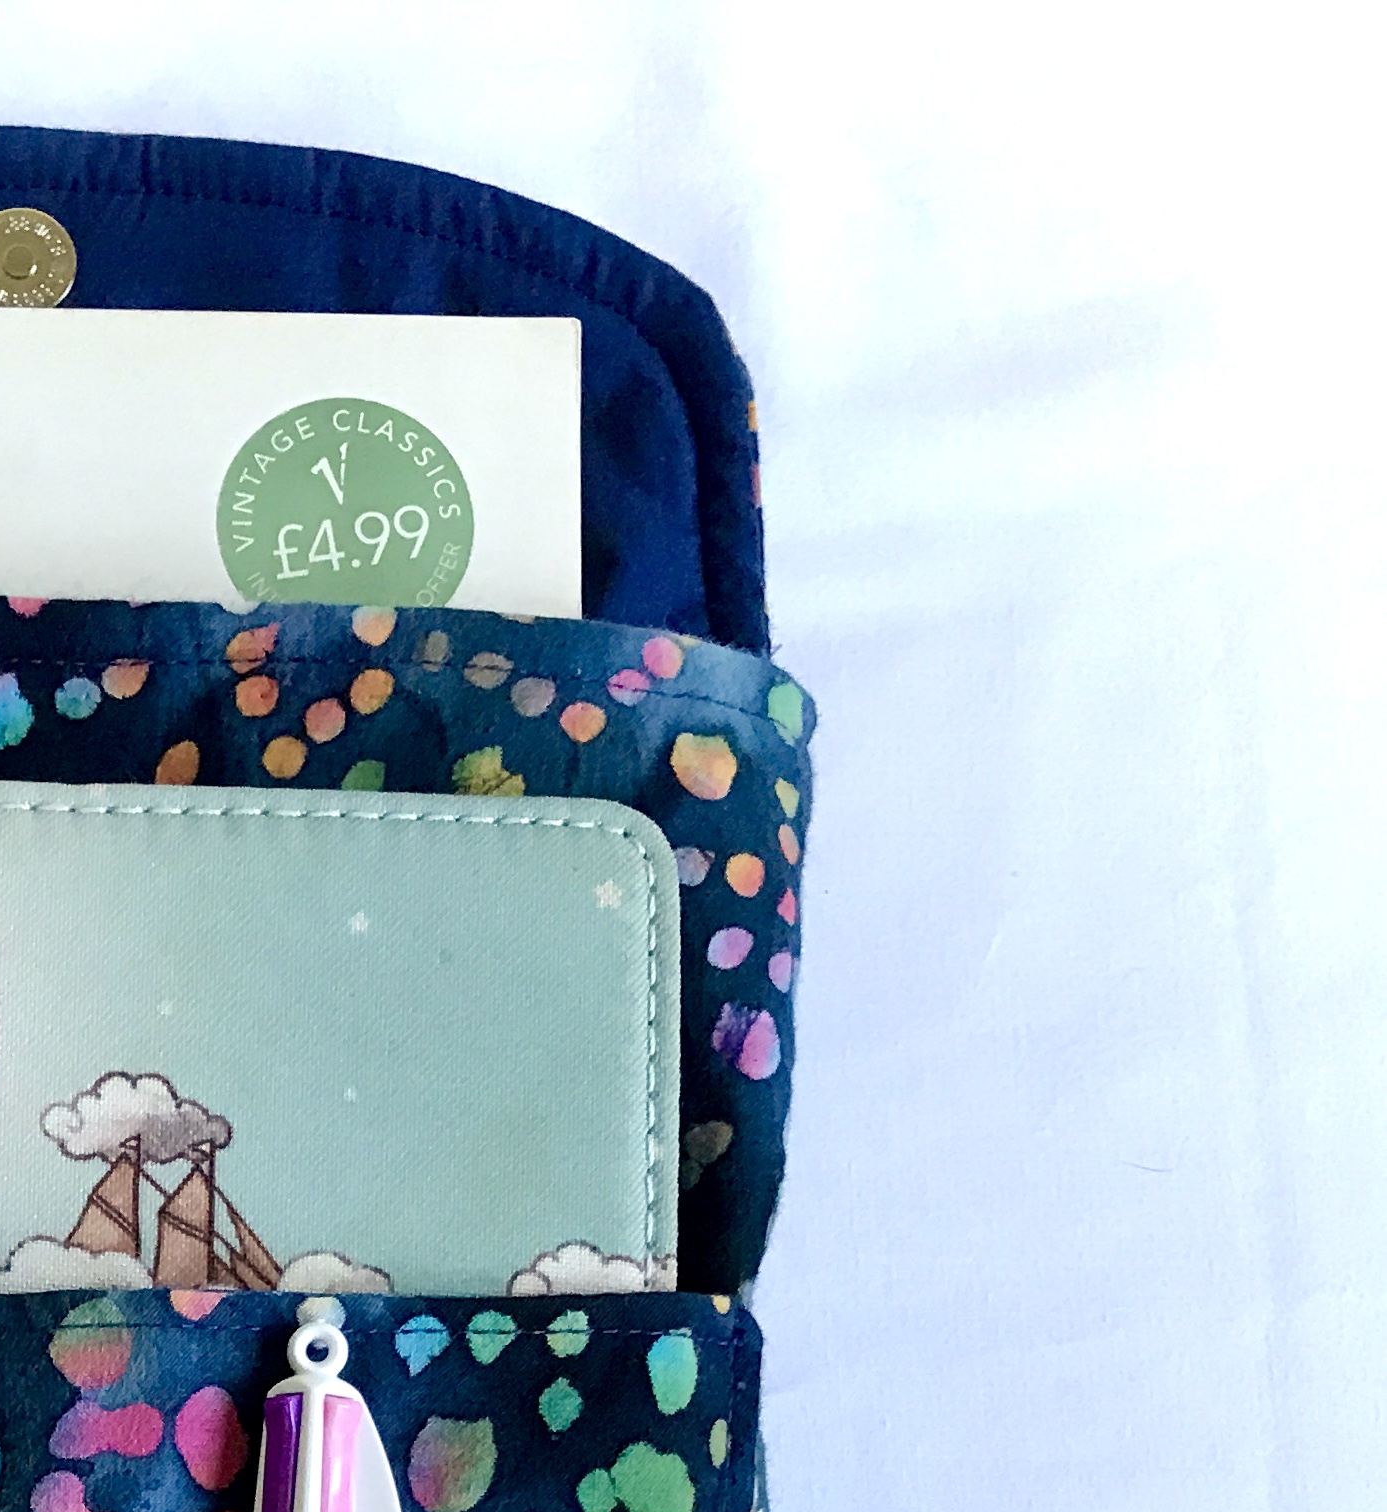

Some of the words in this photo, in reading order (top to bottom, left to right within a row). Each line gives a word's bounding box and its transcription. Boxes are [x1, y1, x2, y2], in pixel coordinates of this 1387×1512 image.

[232, 416, 316, 553] VINTAGE
[332, 409, 461, 519] CLASSICS
[273, 505, 430, 580] £4.99
[416, 542, 462, 607] OFFER
